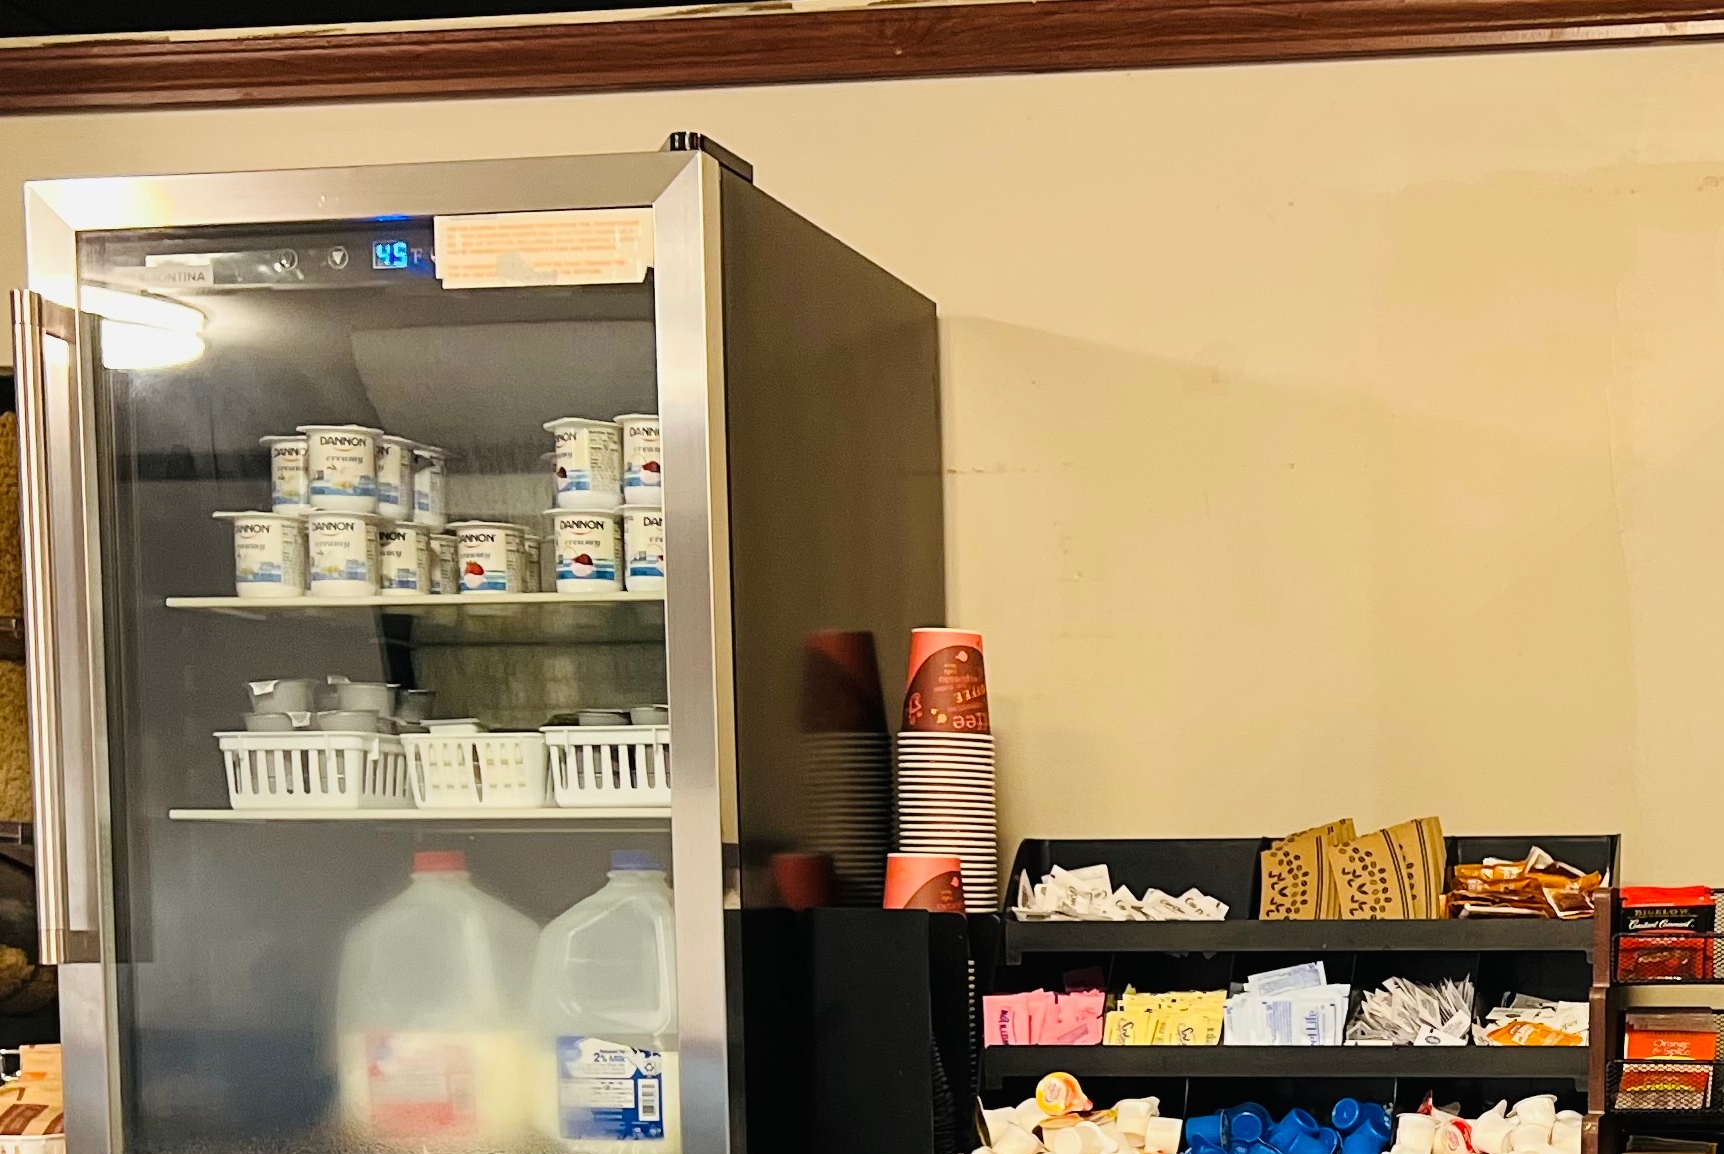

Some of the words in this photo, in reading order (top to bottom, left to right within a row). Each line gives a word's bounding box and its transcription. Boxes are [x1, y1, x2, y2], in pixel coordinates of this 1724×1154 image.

[376, 242, 407, 267] 45
[319, 436, 367, 448] DANNON
[560, 519, 605, 530] DANNON
[1652, 1039, 1691, 1051] Orange
